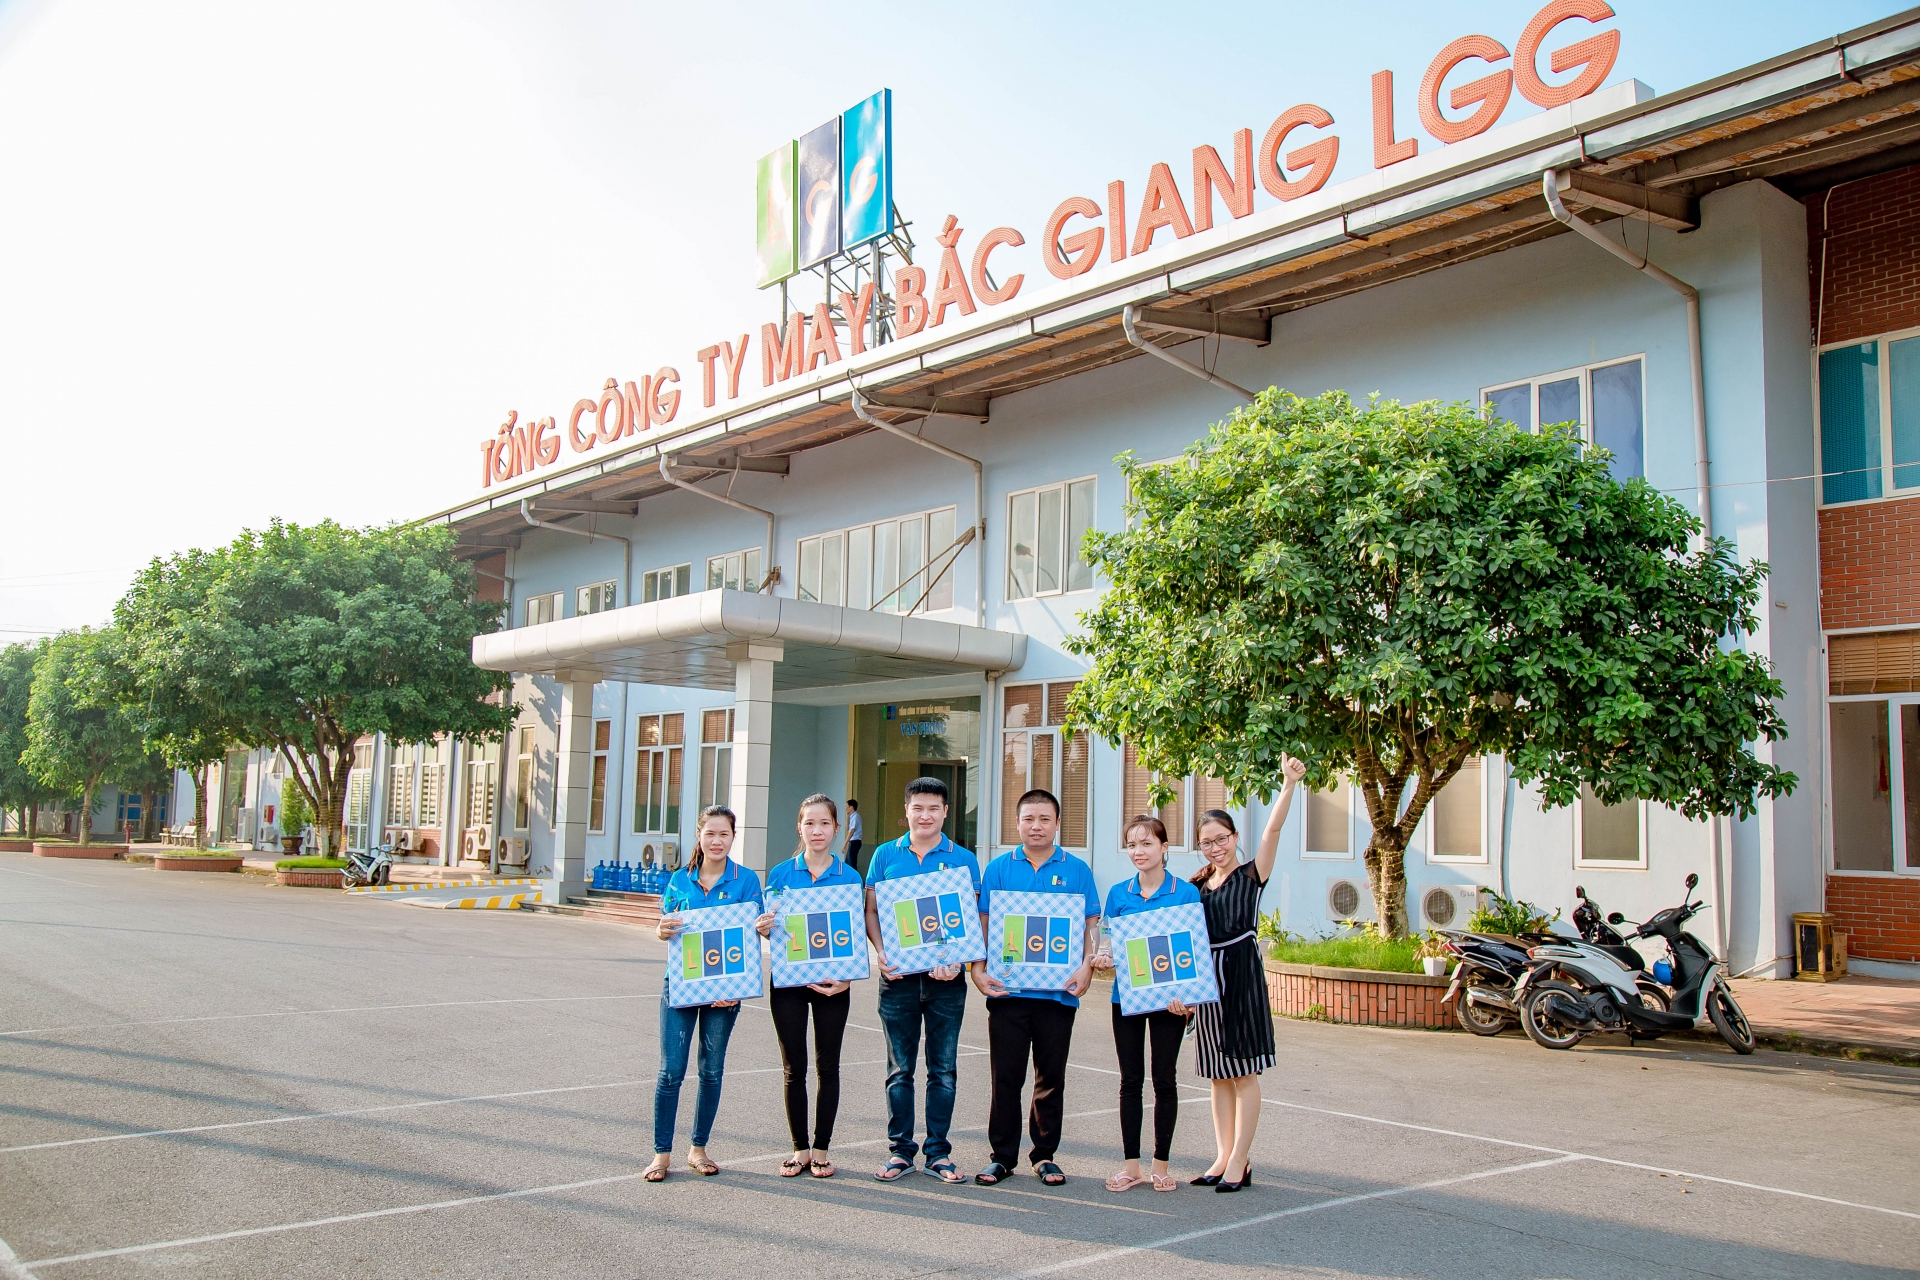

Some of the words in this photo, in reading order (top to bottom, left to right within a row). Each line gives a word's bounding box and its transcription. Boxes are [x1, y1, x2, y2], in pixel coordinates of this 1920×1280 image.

[480, 409, 561, 488] TỔNG
[568, 366, 681, 453] CÔNG
[698, 334, 750, 408] TY
[761, 282, 876, 388] MAY
[895, 214, 1025, 340] BẮC
[1042, 102, 1341, 281] GIANG
[1371, 0, 1622, 171] LGG
